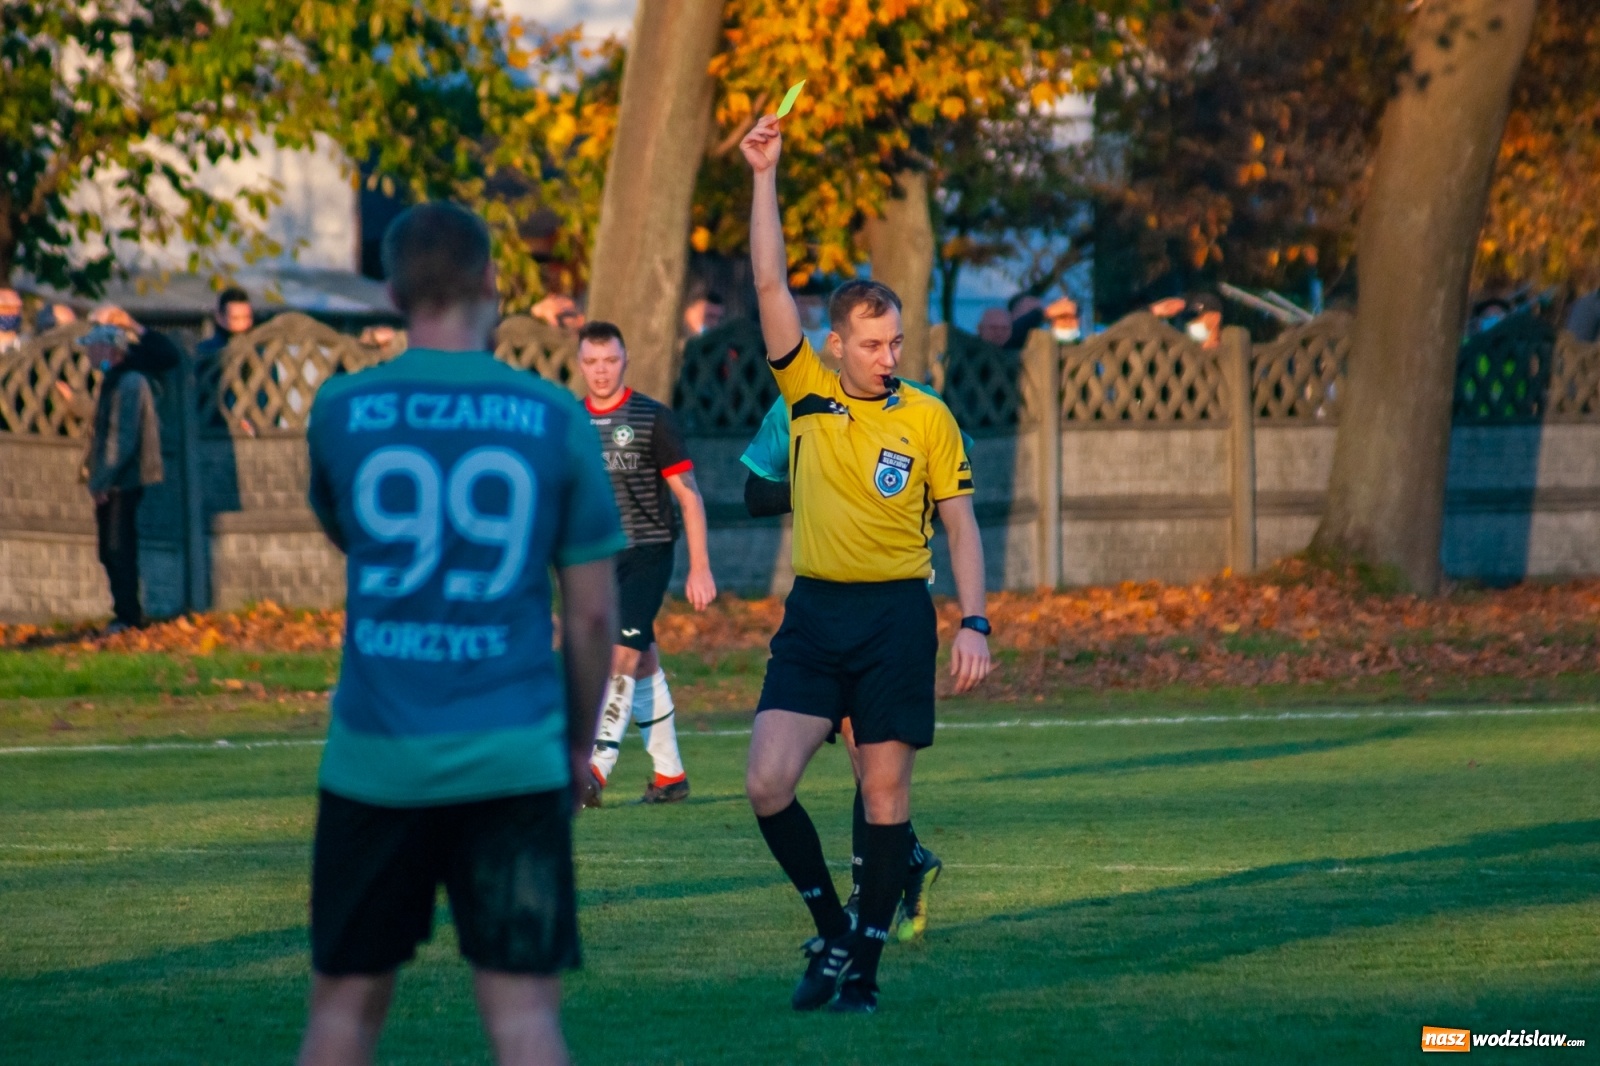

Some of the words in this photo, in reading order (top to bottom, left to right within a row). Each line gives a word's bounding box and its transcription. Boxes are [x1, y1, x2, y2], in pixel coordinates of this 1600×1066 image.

[349, 392, 398, 432] KS
[405, 393, 545, 437] CZARNI
[354, 445, 538, 601] 99
